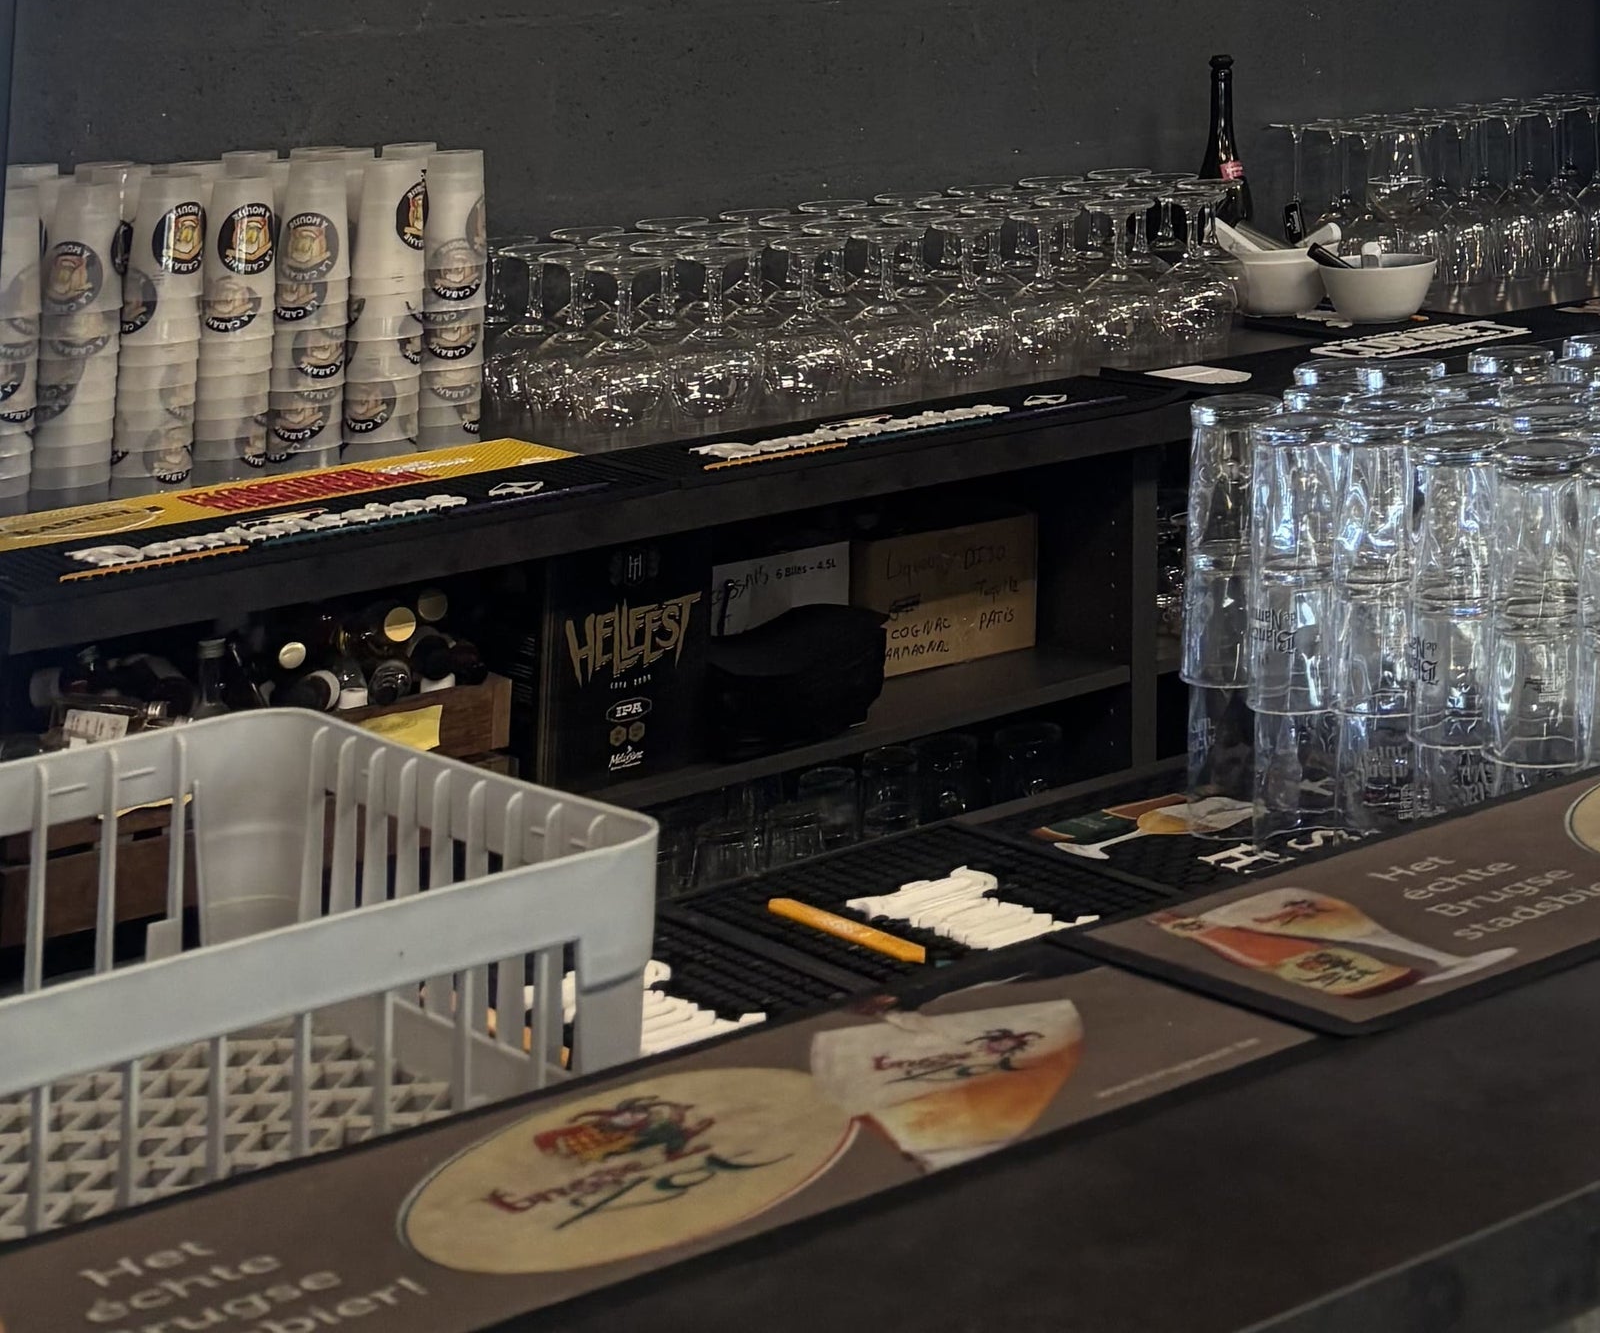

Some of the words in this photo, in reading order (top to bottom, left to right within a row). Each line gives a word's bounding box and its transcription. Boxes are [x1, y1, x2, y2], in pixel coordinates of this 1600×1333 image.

[565, 591, 702, 688] HELLFEST
[615, 701, 643, 719] IPA
[1368, 855, 1456, 883] Het
[1426, 868, 1575, 918] Brugse
[80, 1240, 215, 1288] Het
